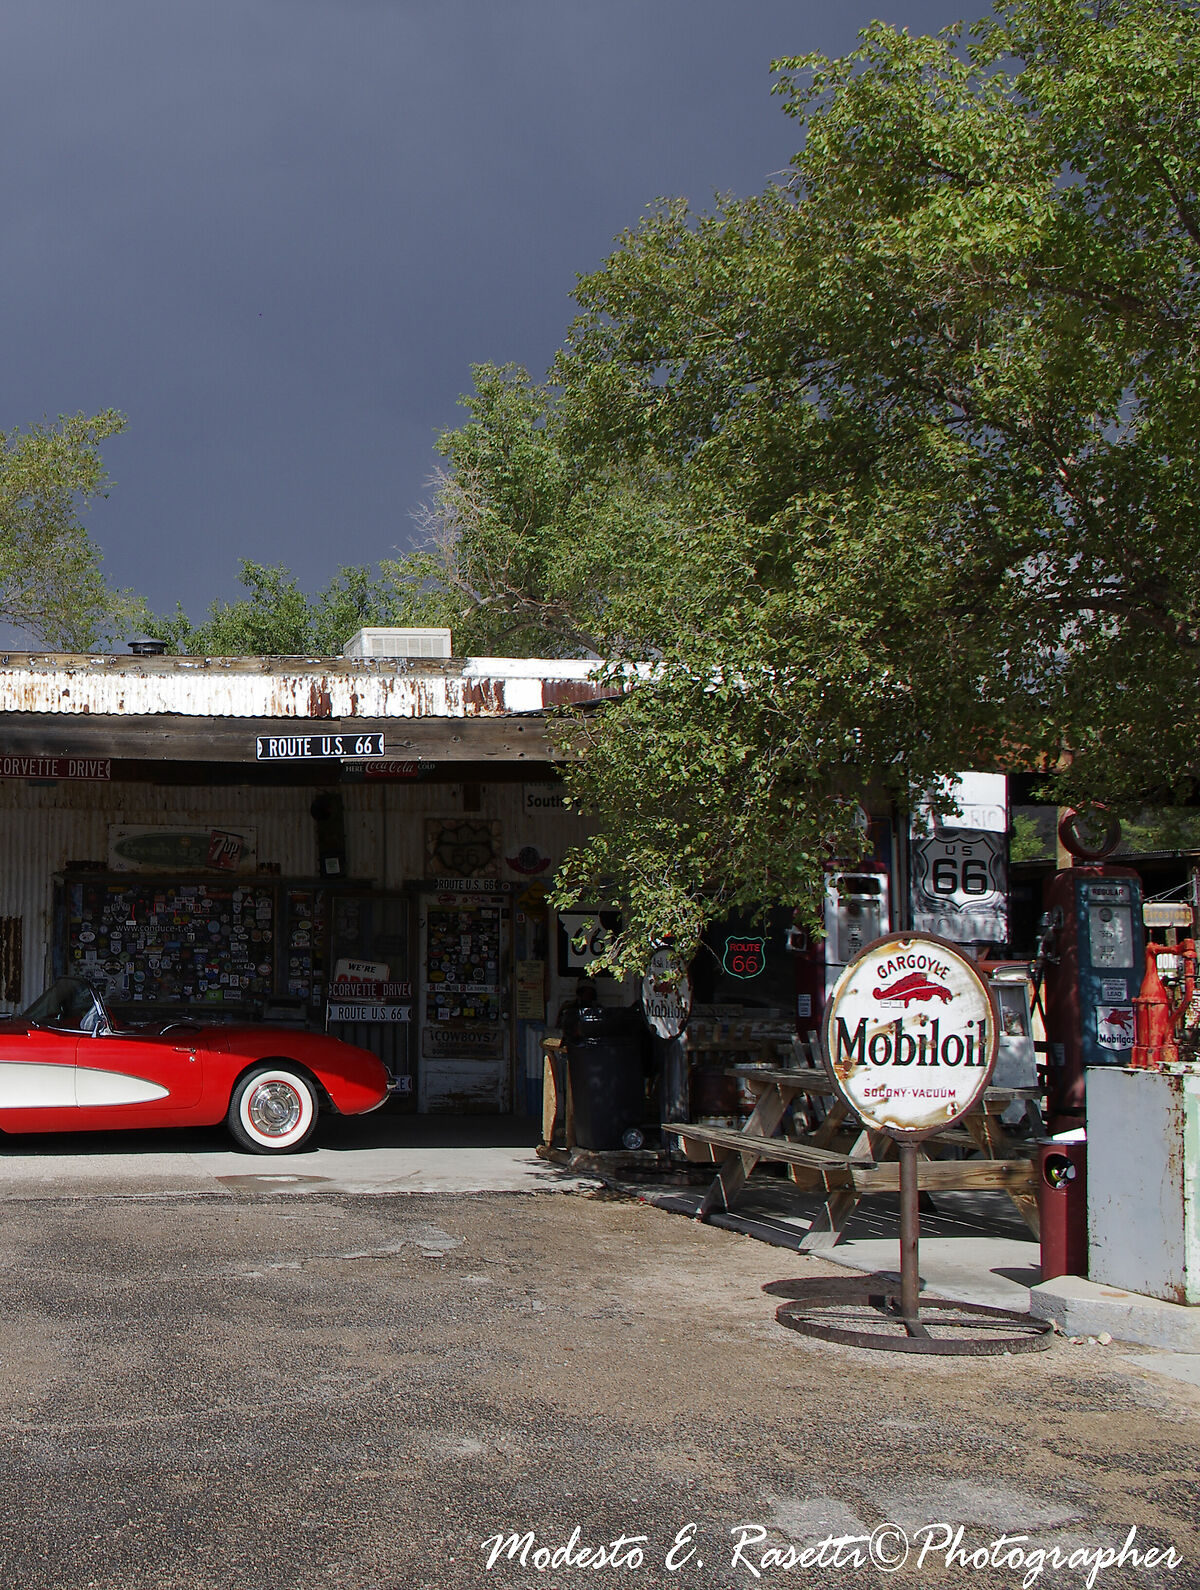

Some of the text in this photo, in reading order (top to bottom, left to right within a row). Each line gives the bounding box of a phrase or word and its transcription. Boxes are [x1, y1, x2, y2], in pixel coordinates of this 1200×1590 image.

[269, 736, 373, 756] ROUTE U.S. 66
[68, 760, 105, 778] DRIVE
[945, 845, 973, 856] US
[933, 859, 987, 895] 66
[439, 880, 463, 889] ROUTE
[465, 880, 481, 889] U.S.
[1092, 888, 1124, 896] REGULAR
[730, 944, 760, 952] ROUTE
[348, 963, 377, 974] WE'RE
[733, 955, 758, 973] 66
[877, 954, 950, 981] GARGOYLE
[333, 984, 407, 996] CORVETTE DRIVE
[338, 1007, 402, 1020] ROUTE U.S. 66
[834, 1017, 987, 1067] Mobiloil
